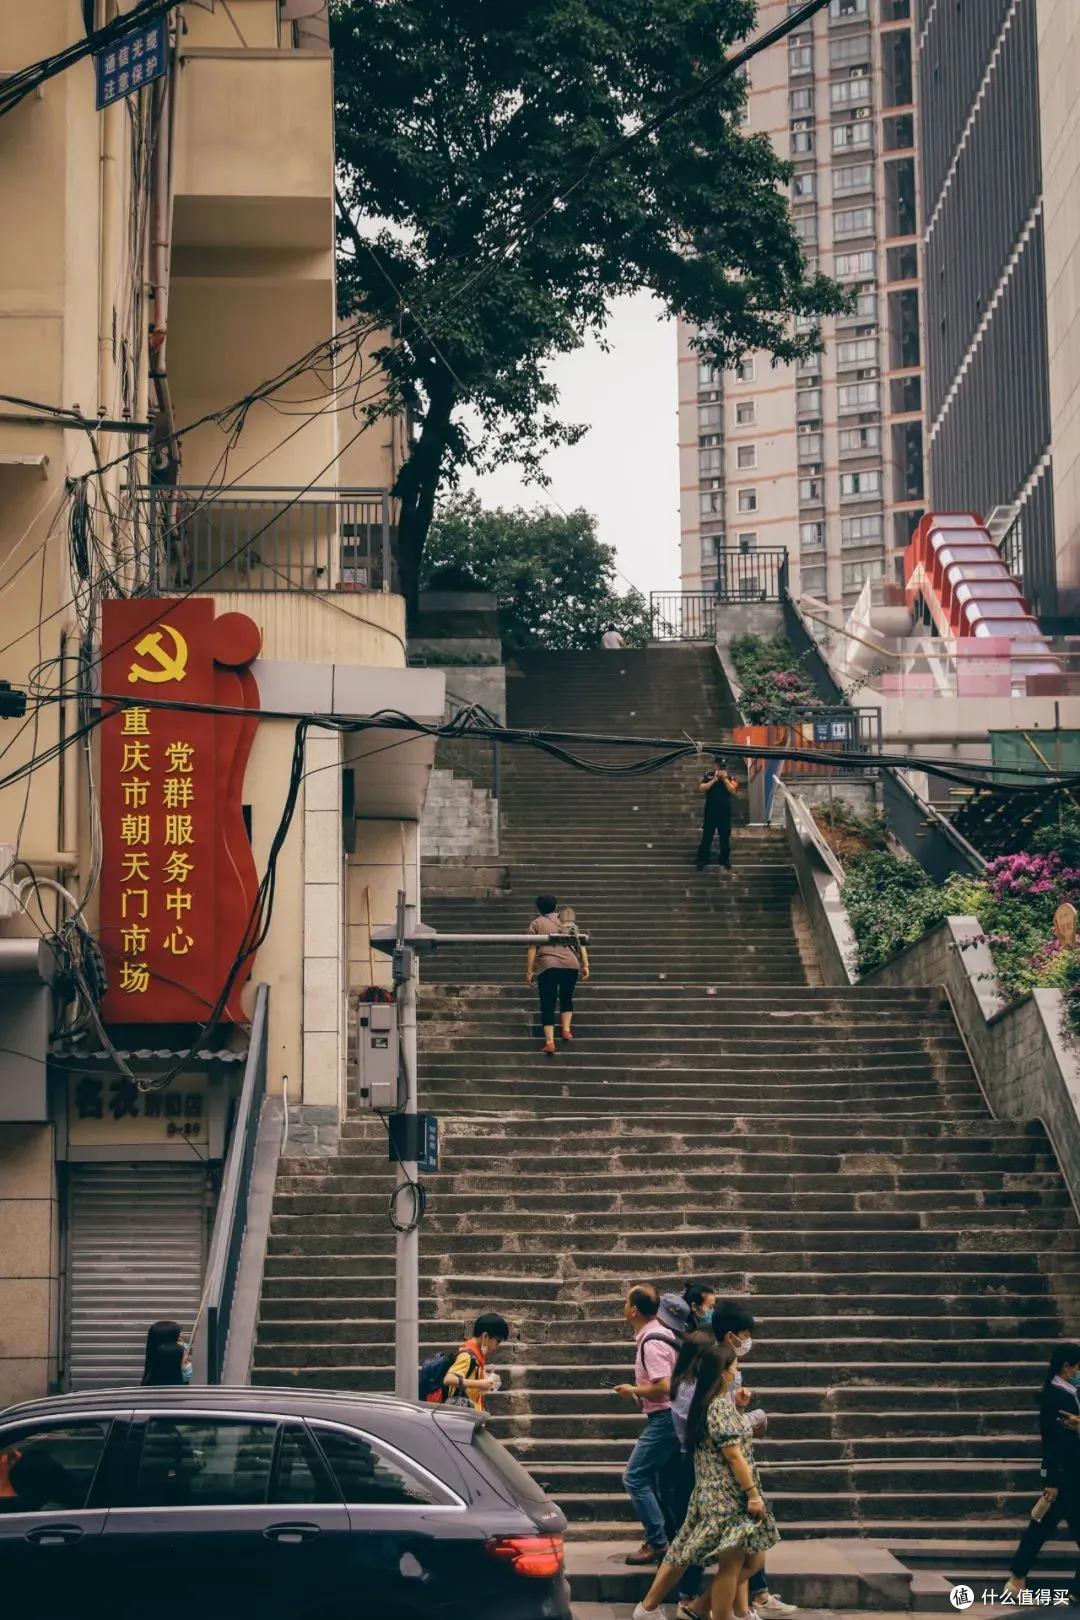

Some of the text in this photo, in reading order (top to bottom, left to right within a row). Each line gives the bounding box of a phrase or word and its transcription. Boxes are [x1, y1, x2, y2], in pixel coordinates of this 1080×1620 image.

[104, 30, 158, 75] 通信光缆
[104, 56, 158, 101] 注意保护
[120, 706, 151, 993] 重庆市朝天门市场
[163, 741, 194, 955] 党群服务中心
